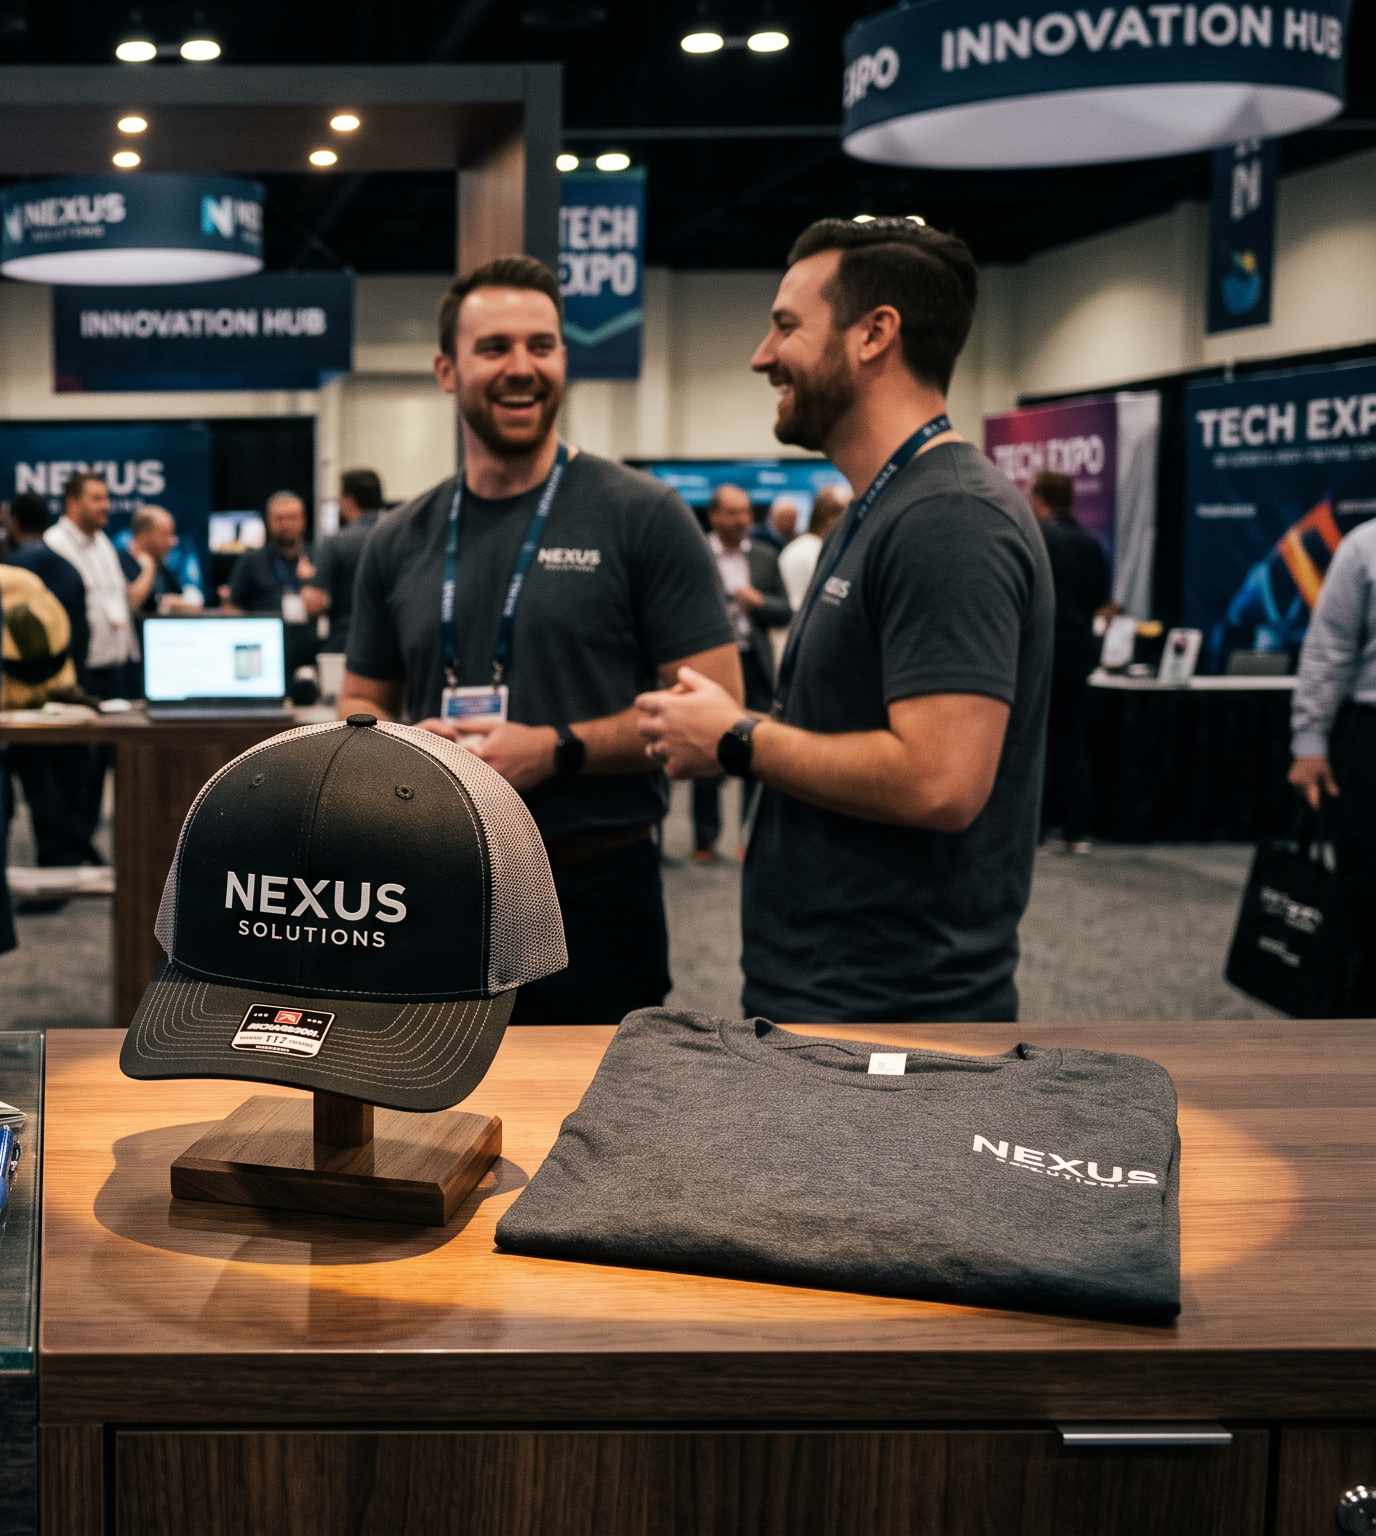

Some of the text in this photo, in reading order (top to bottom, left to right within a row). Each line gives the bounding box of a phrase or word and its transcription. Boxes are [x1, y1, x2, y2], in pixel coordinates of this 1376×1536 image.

[942, 5, 1271, 71] INNOVATION
[1284, 10, 1341, 58] HUB
[26, 193, 126, 227] NEXUS
[559, 205, 638, 250] TECH
[81, 307, 326, 338] INNOVATION HUB
[1196, 402, 1295, 448] TECH
[537, 547, 601, 566] NEXUS
[225, 871, 407, 923] NEXUS
[238, 920, 385, 948] SOLUTIONS
[973, 1134, 1159, 1185] NEXUS
